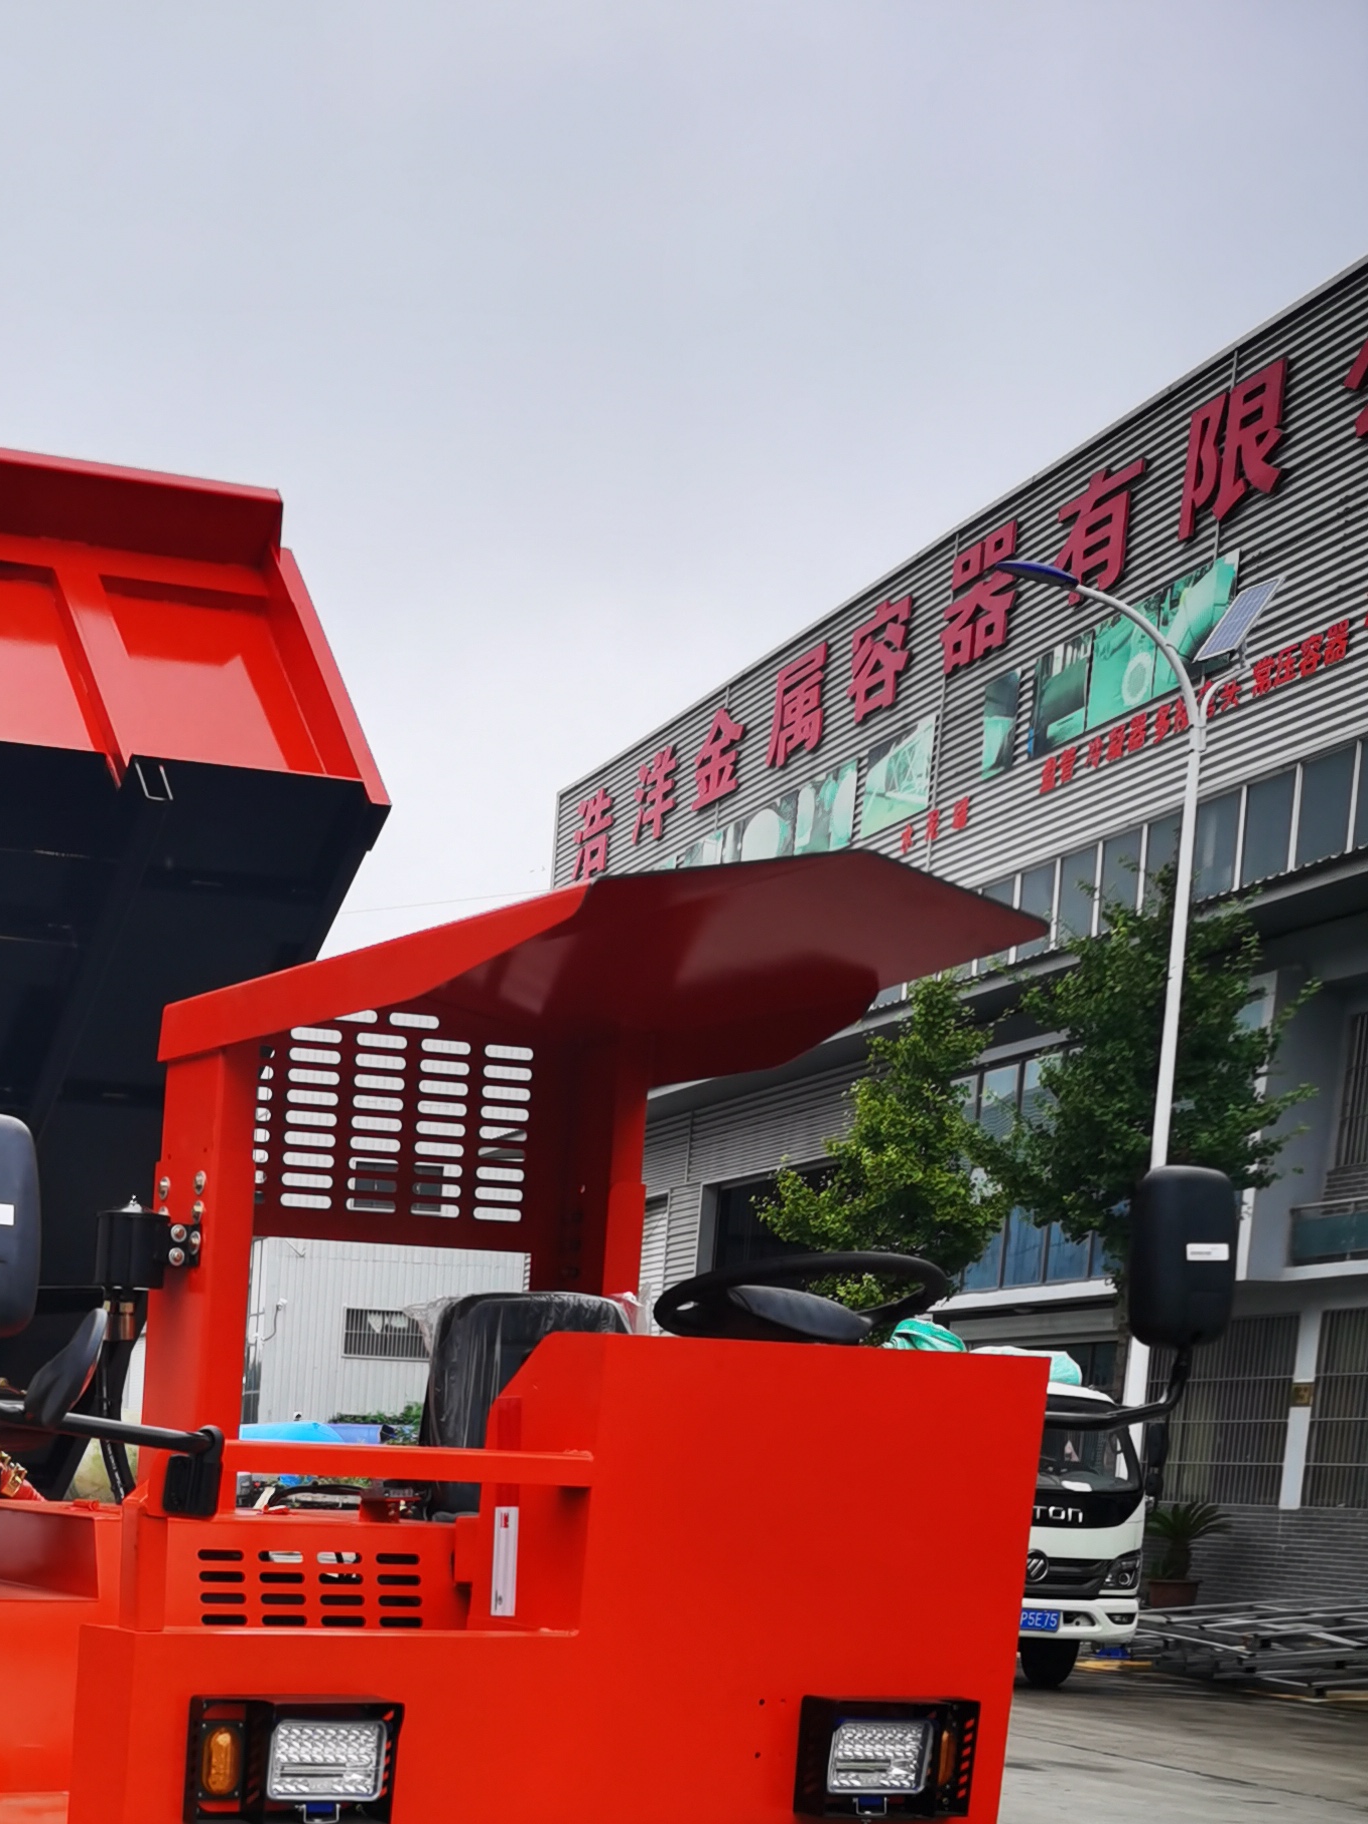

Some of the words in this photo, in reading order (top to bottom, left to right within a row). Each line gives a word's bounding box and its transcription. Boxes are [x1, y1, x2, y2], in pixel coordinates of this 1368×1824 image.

[570, 337, 1368, 880] 浩洋金属容器有限
